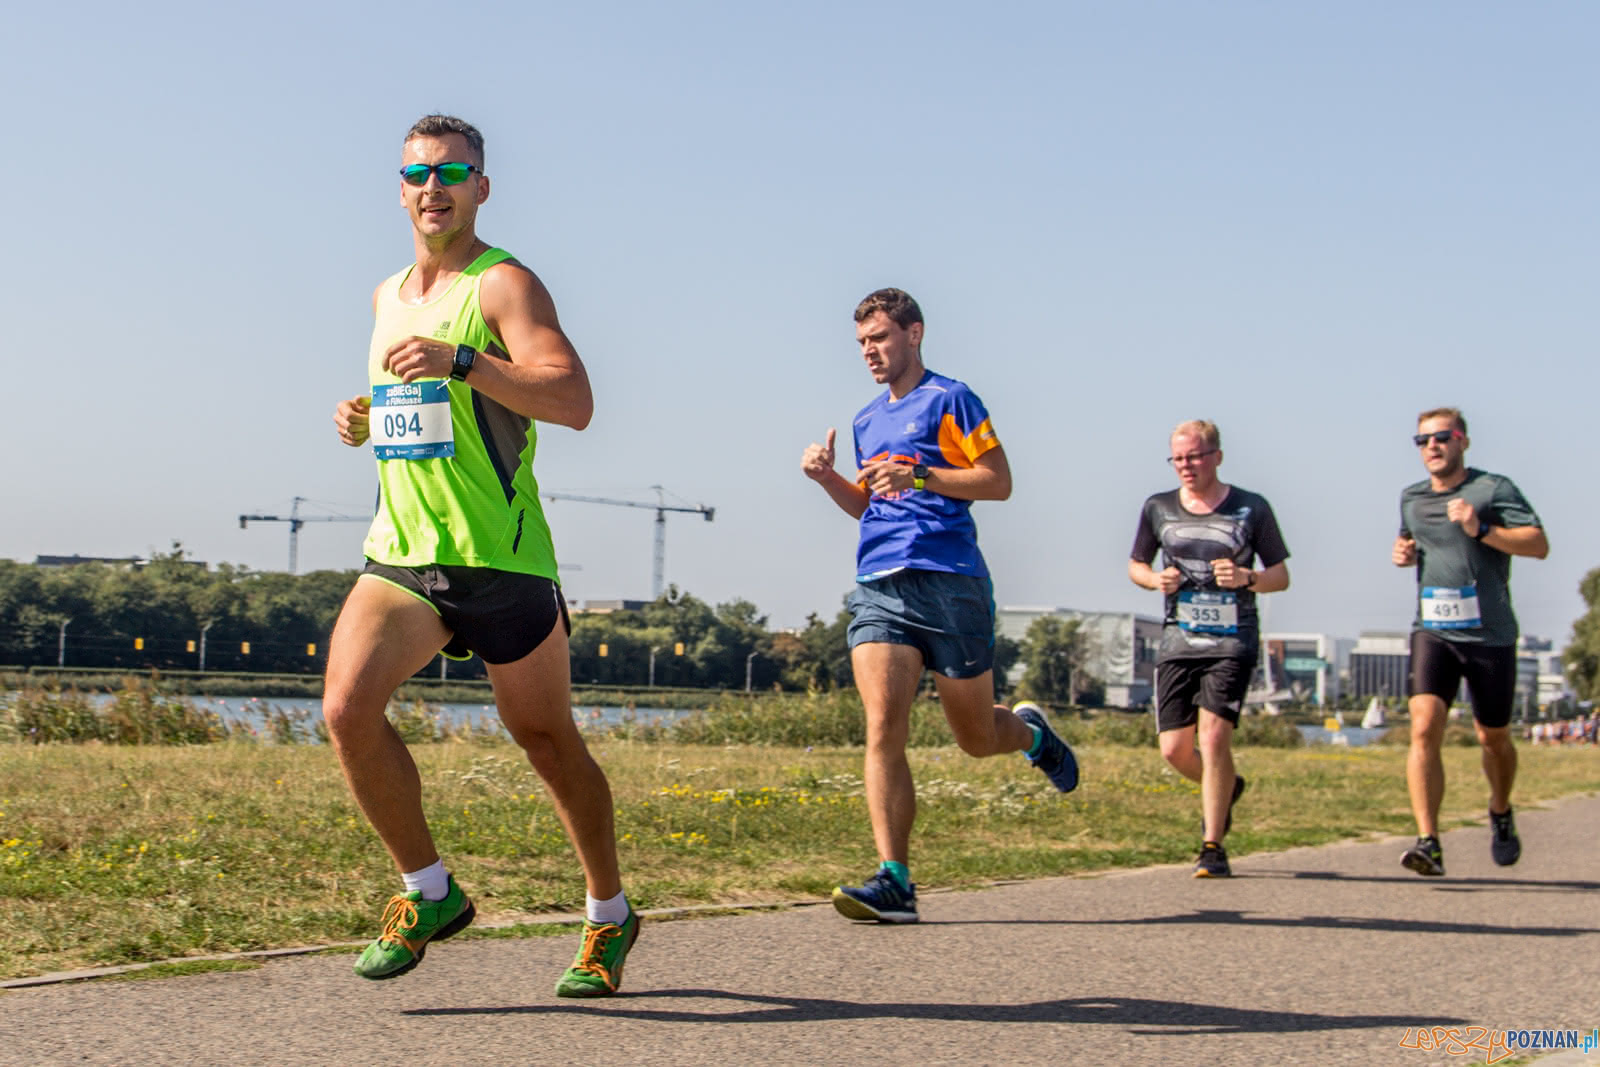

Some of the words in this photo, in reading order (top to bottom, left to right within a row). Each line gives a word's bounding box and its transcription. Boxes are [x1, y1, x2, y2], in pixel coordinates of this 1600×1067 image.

[384, 411, 423, 438] 094
[1191, 607, 1220, 622] 353
[1433, 603, 1460, 617] 491
